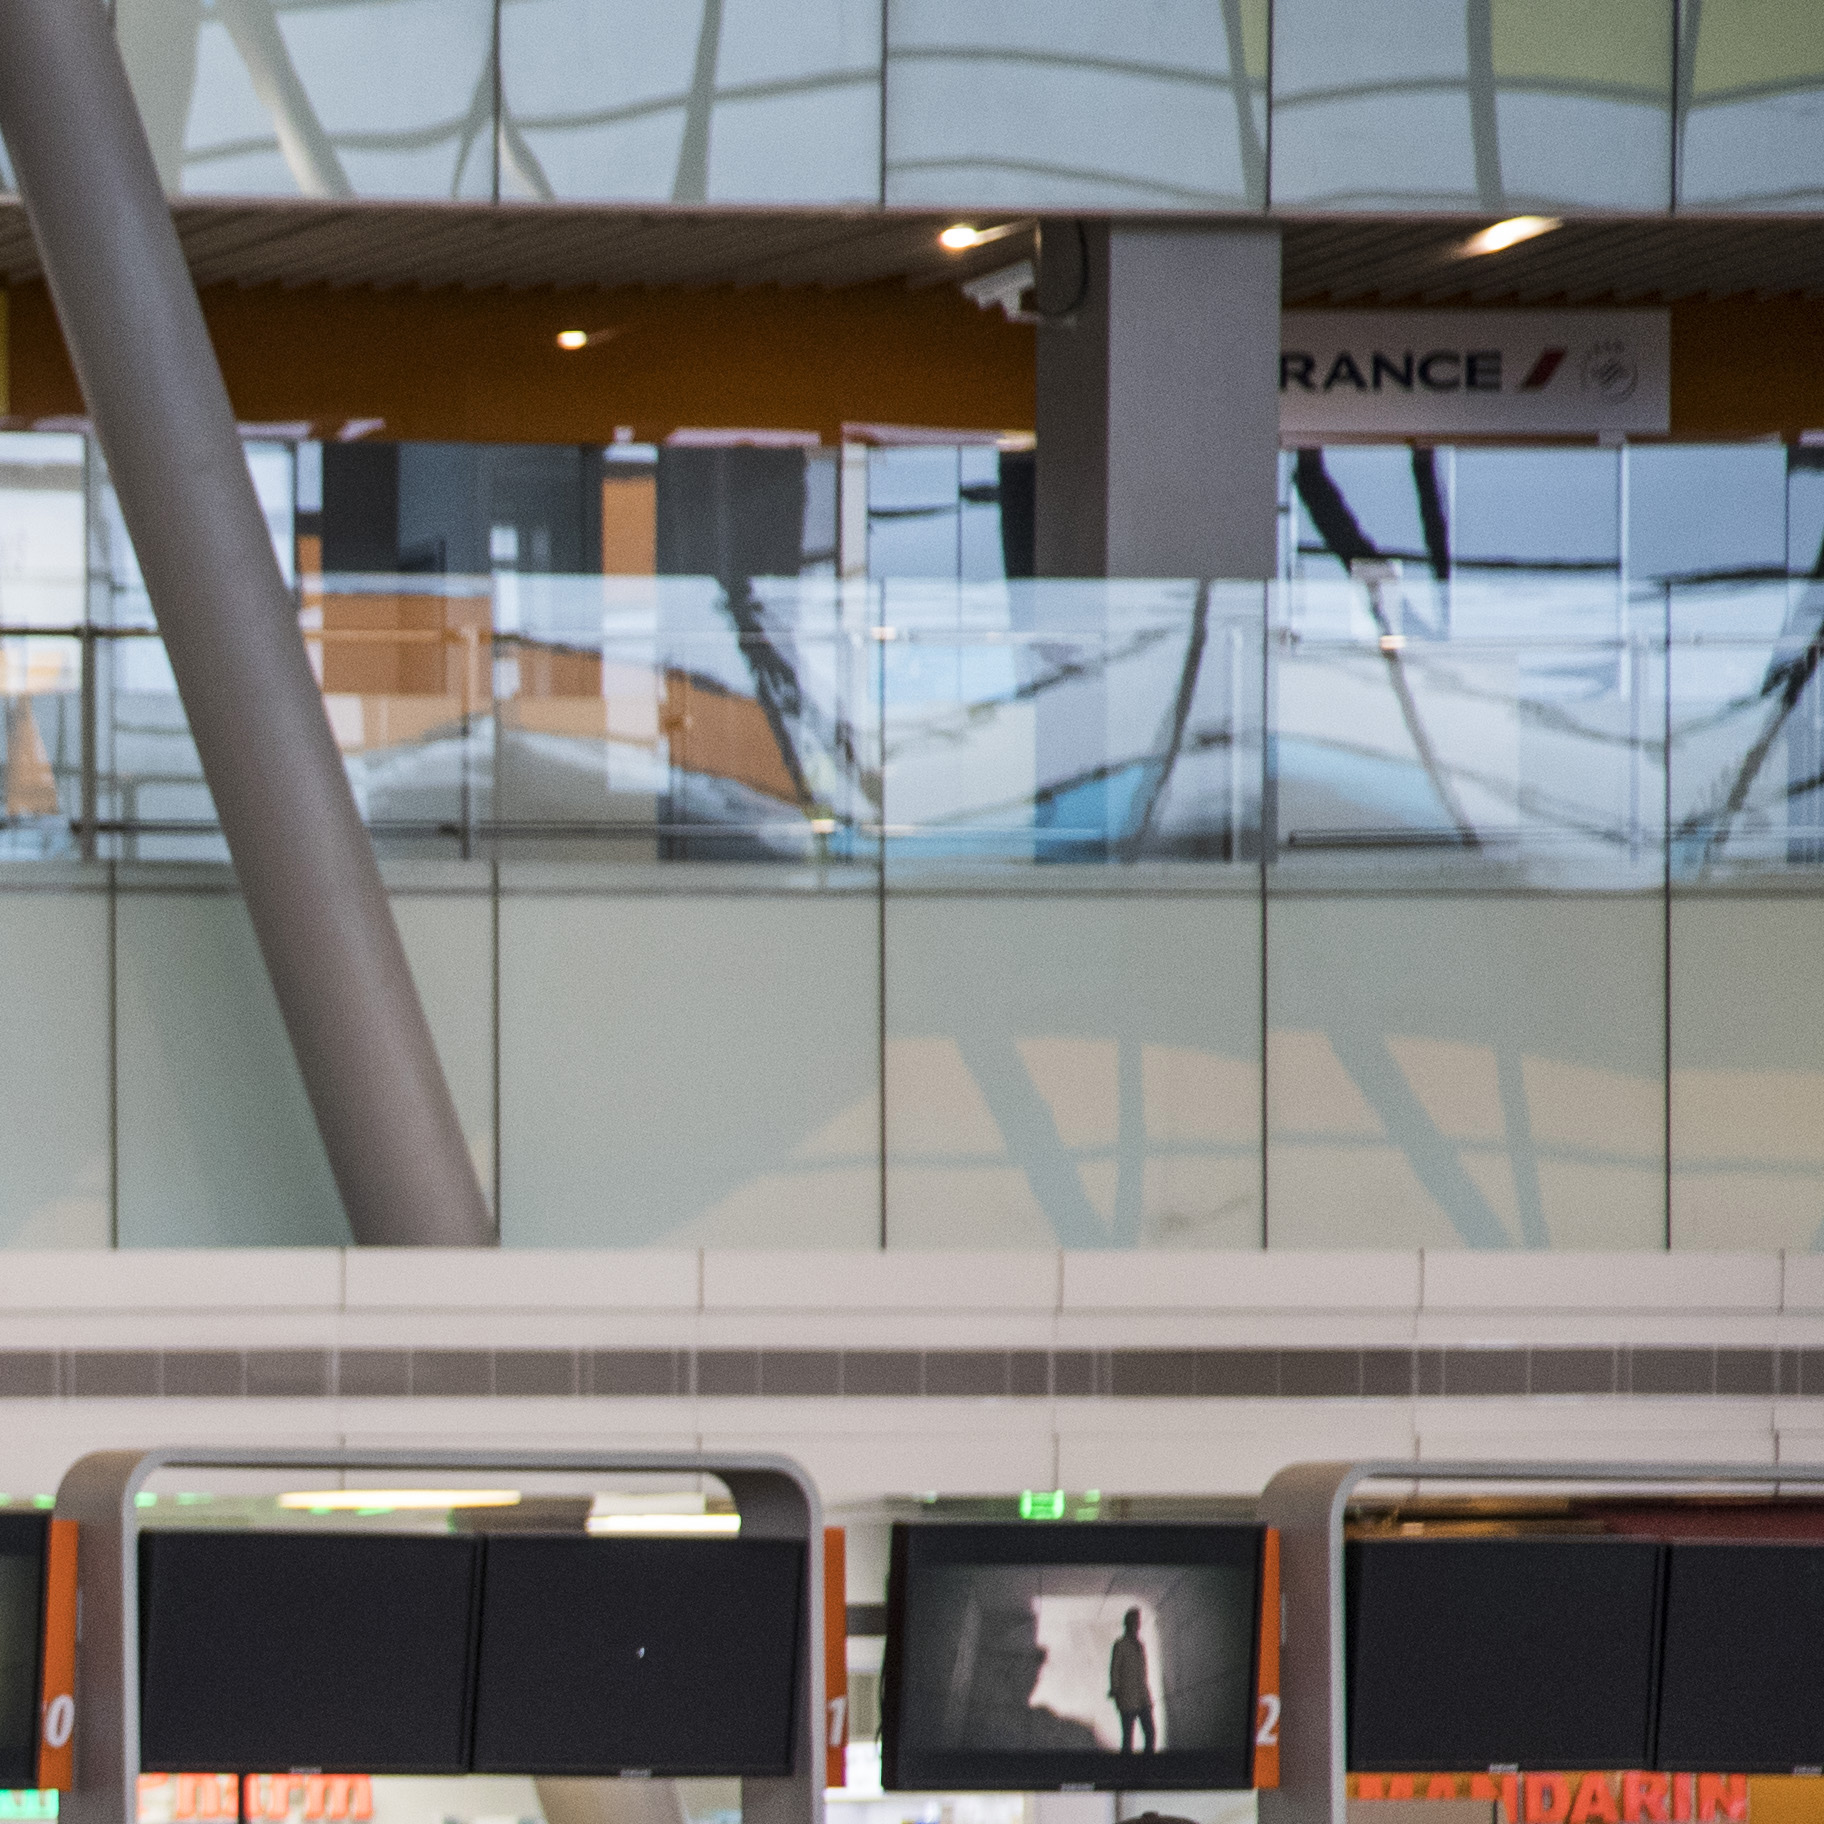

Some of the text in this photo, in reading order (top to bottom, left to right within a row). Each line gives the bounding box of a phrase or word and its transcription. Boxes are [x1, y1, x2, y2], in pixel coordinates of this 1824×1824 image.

[1280, 349, 1502, 392] RANCE
[45, 1695, 74, 1748] 0
[828, 1696, 847, 1747] 1
[1256, 1694, 1280, 1746] 2
